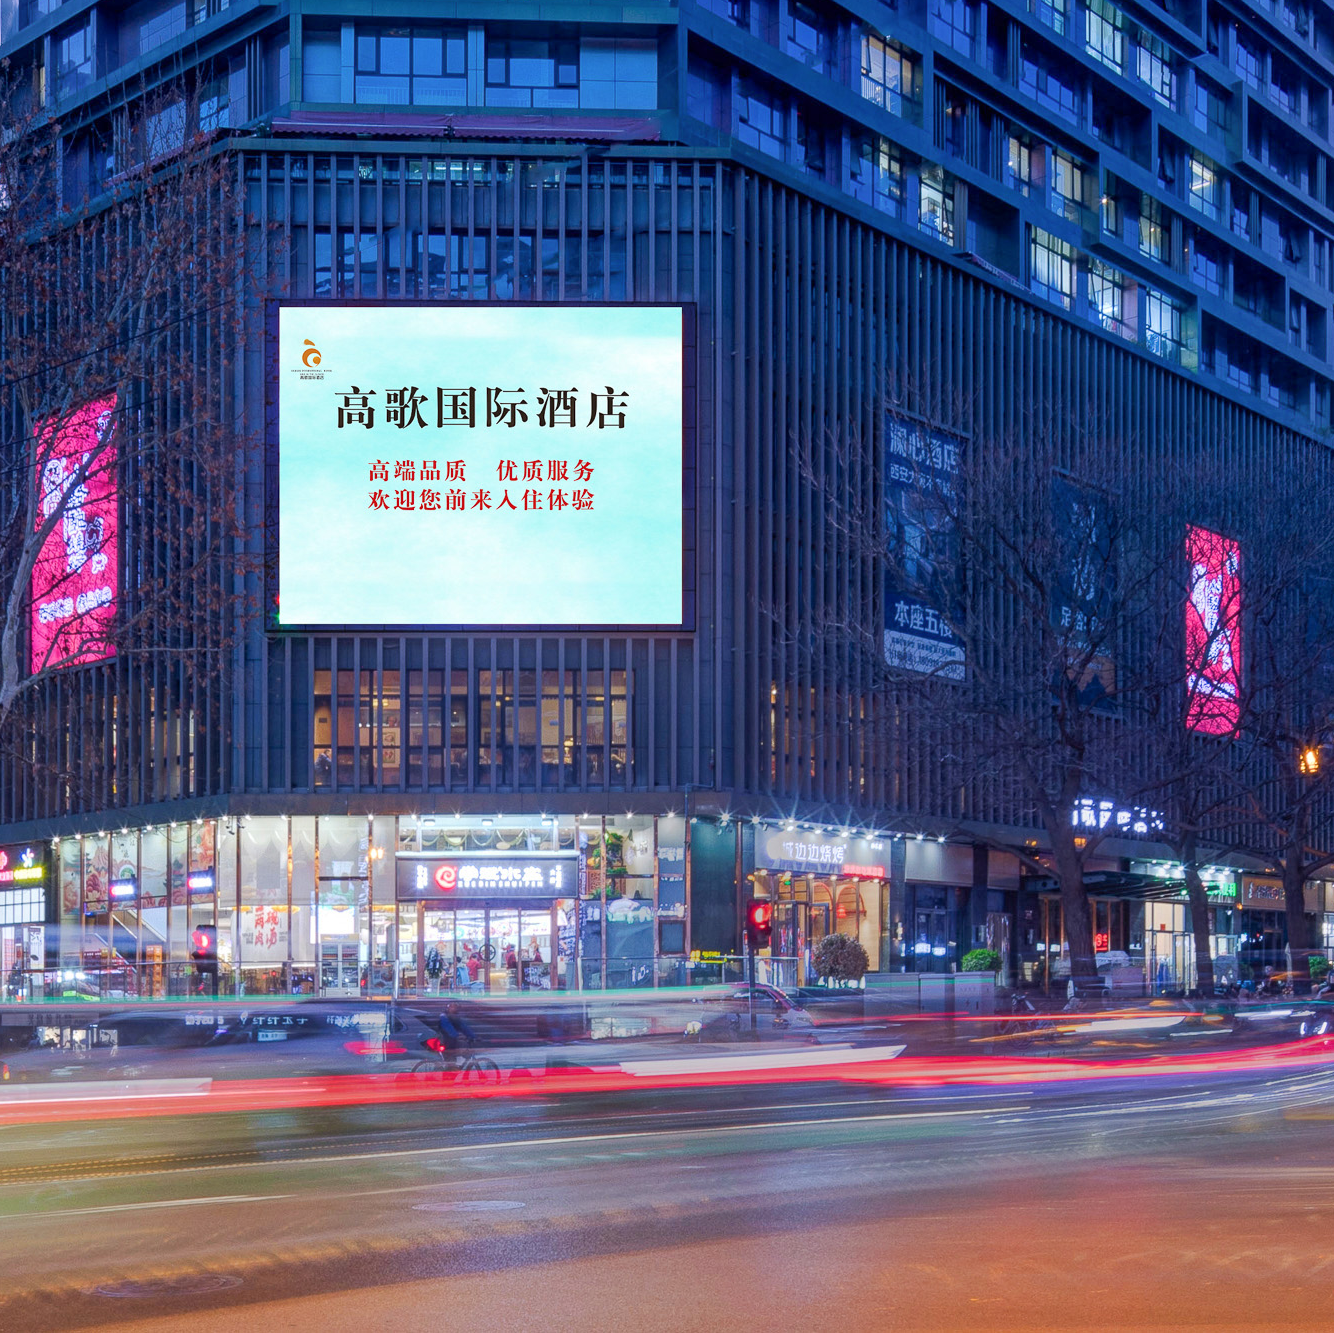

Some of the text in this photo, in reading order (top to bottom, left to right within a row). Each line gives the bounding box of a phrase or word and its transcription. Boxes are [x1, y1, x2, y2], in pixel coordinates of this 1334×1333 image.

[335, 385, 630, 429] 高歌国际酒店
[367, 459, 596, 483] 高端品质 优质服务
[367, 488, 596, 512] 欢迎您前来入住体验
[894, 600, 954, 640] 本座五楼
